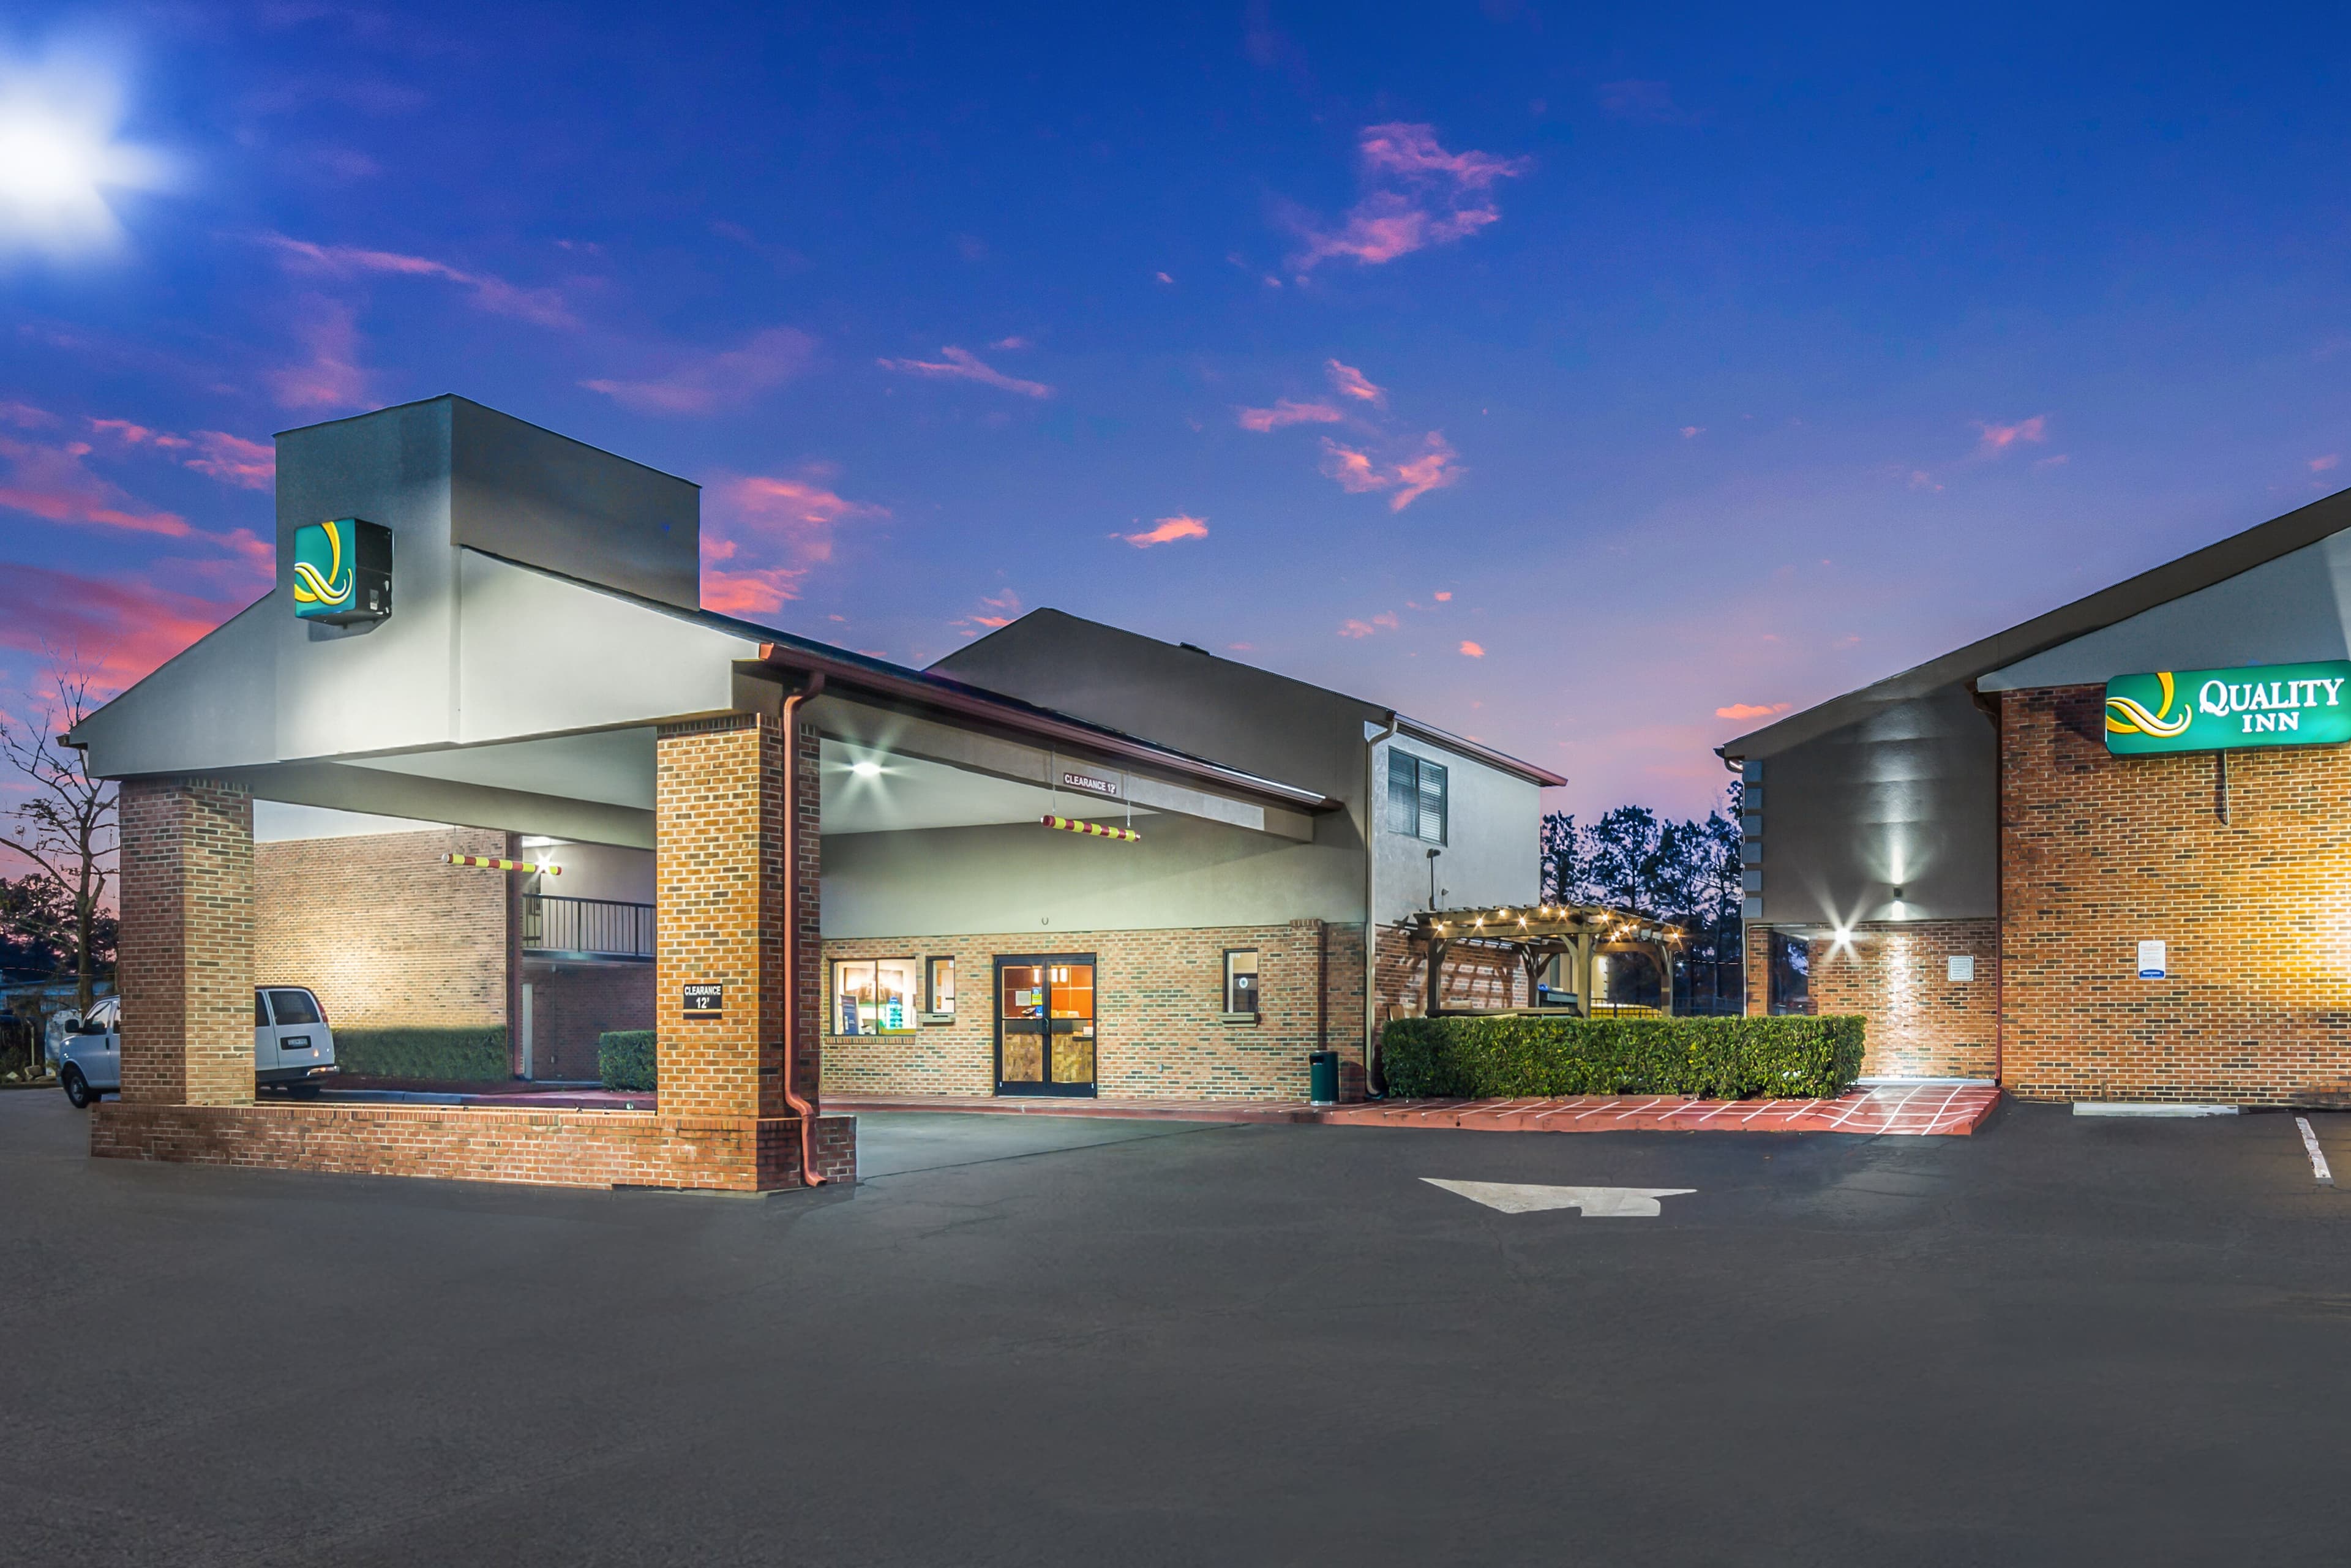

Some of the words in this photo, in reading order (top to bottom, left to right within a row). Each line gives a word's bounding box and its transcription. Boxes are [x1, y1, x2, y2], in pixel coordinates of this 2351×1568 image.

[2199, 678, 2345, 717] QUALITY
[2241, 711, 2300, 733] INN
[1064, 774, 1106, 791] CLEARANCE
[684, 986, 721, 996] CLEARANCE
[696, 997, 710, 1009] 12'
